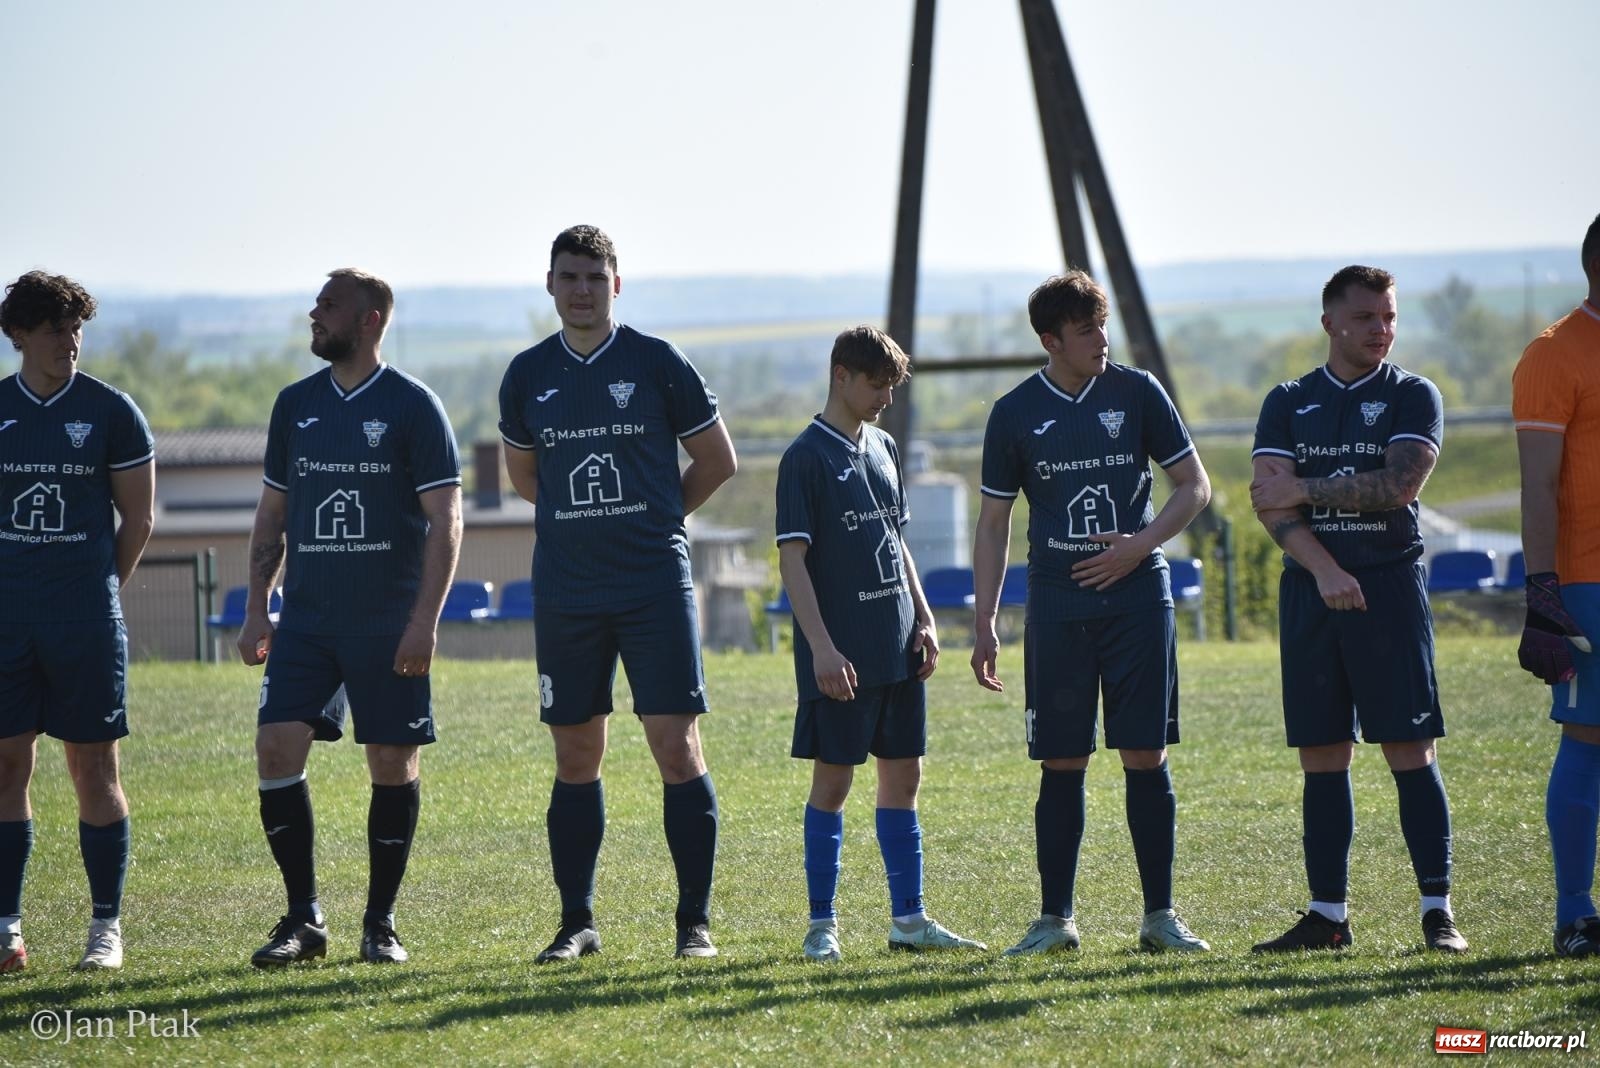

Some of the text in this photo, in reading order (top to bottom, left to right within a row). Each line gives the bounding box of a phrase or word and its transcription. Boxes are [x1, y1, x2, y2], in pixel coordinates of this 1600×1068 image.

[557, 424, 645, 440] MASTER GSM
[1308, 442, 1387, 457] MASTR GSM
[3, 463, 95, 475] MASTER GSM
[309, 461, 391, 473] MASTER GSM
[1052, 453, 1134, 473] MASTER GSM
[555, 501, 648, 520] Bauservice Lisowski
[858, 509, 889, 522] MASE
[1311, 521, 1387, 532] rvice Lisowski
[0, 530, 87, 543] auservice Lisowski
[347, 540, 391, 552] Lisowski
[1048, 537, 1101, 552] Bauservice
